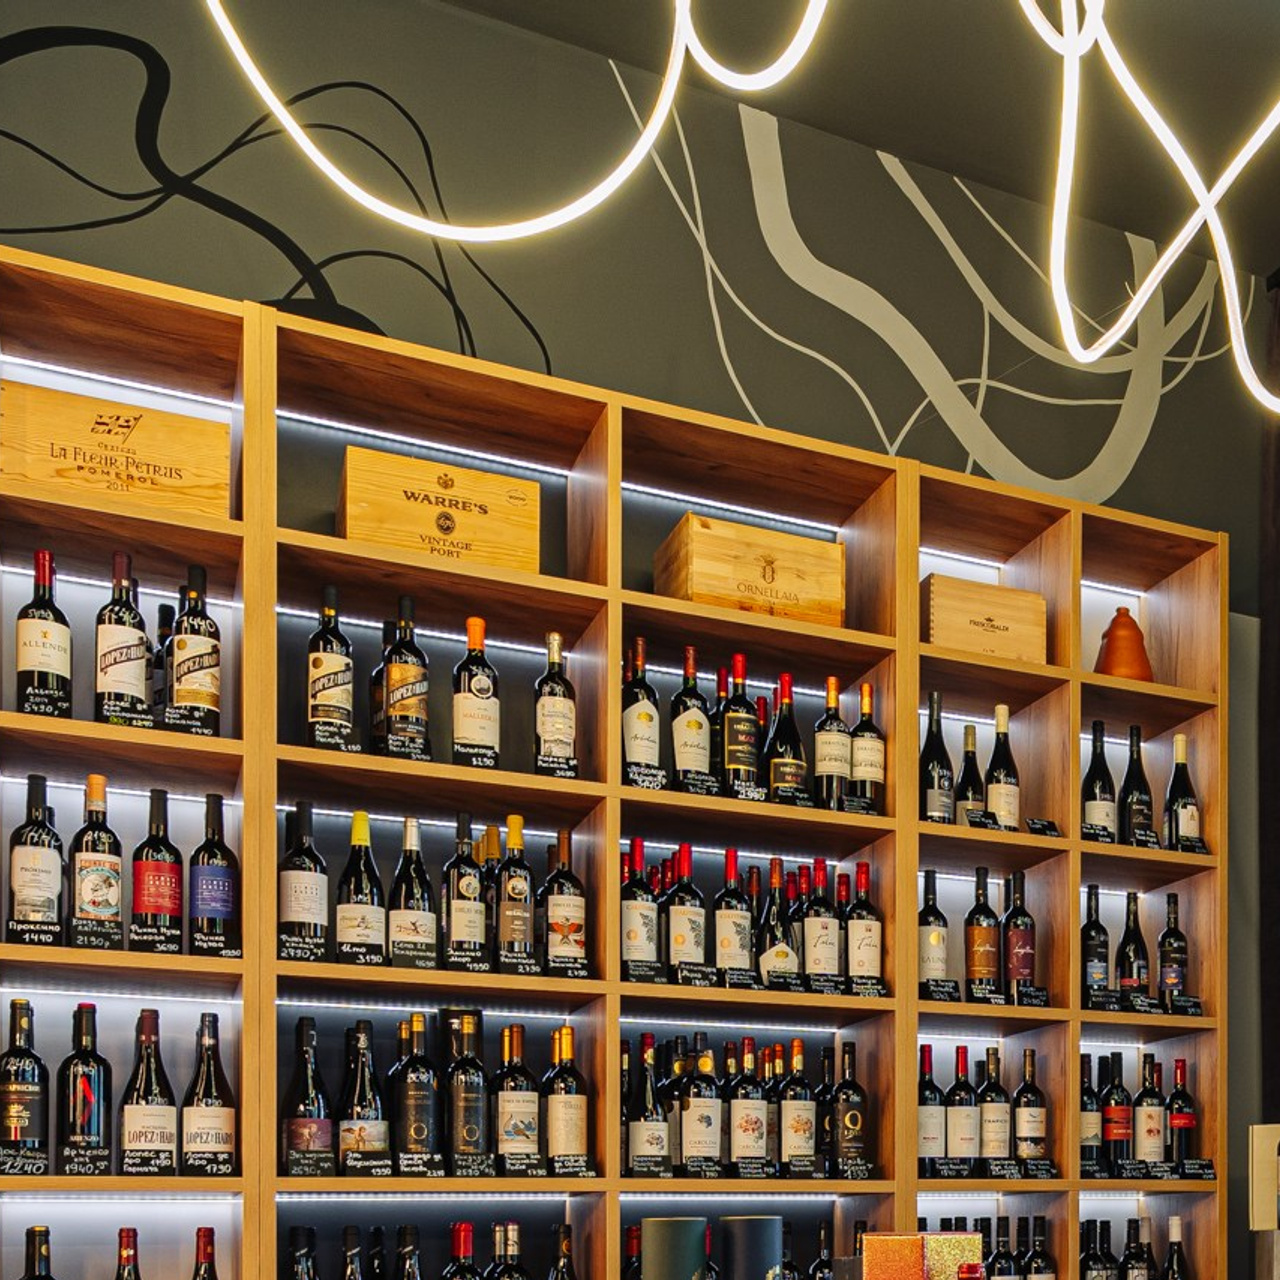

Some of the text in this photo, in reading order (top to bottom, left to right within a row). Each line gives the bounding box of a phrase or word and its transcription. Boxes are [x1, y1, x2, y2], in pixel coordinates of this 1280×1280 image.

[77, 465, 159, 487] POMEROL
[402, 489, 489, 515] WARRE'S
[419, 534, 473, 551] VINTAGE
[429, 546, 463, 559] PORT
[736, 583, 800, 604] ORNELLAIA
[21, 640, 68, 654] ALLENDE
